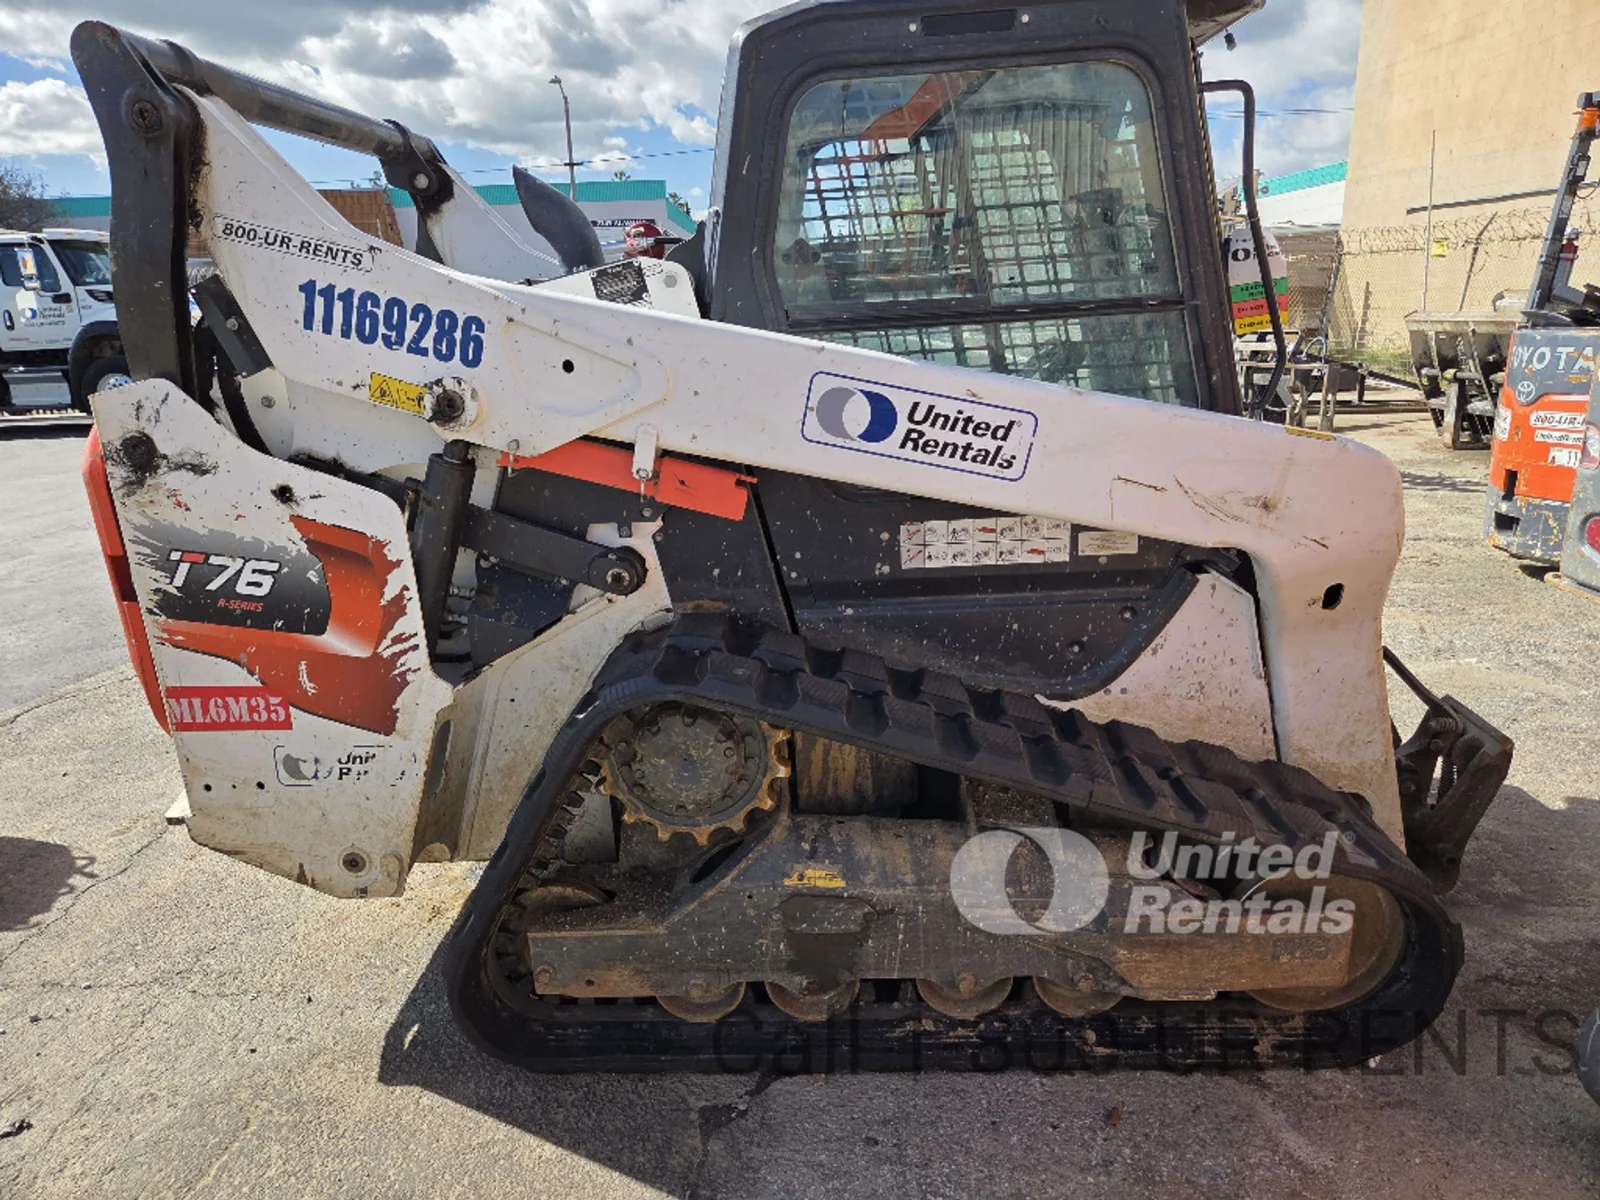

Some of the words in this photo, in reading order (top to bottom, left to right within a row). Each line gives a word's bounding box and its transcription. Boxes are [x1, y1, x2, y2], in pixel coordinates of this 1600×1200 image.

[221, 222, 364, 268] 800-UR-RENTS
[298, 278, 486, 369] 11169286
[907, 401, 1017, 442] United
[898, 428, 1018, 470] Rentals
[168, 550, 281, 597] T76
[216, 598, 265, 612] R-SERIES
